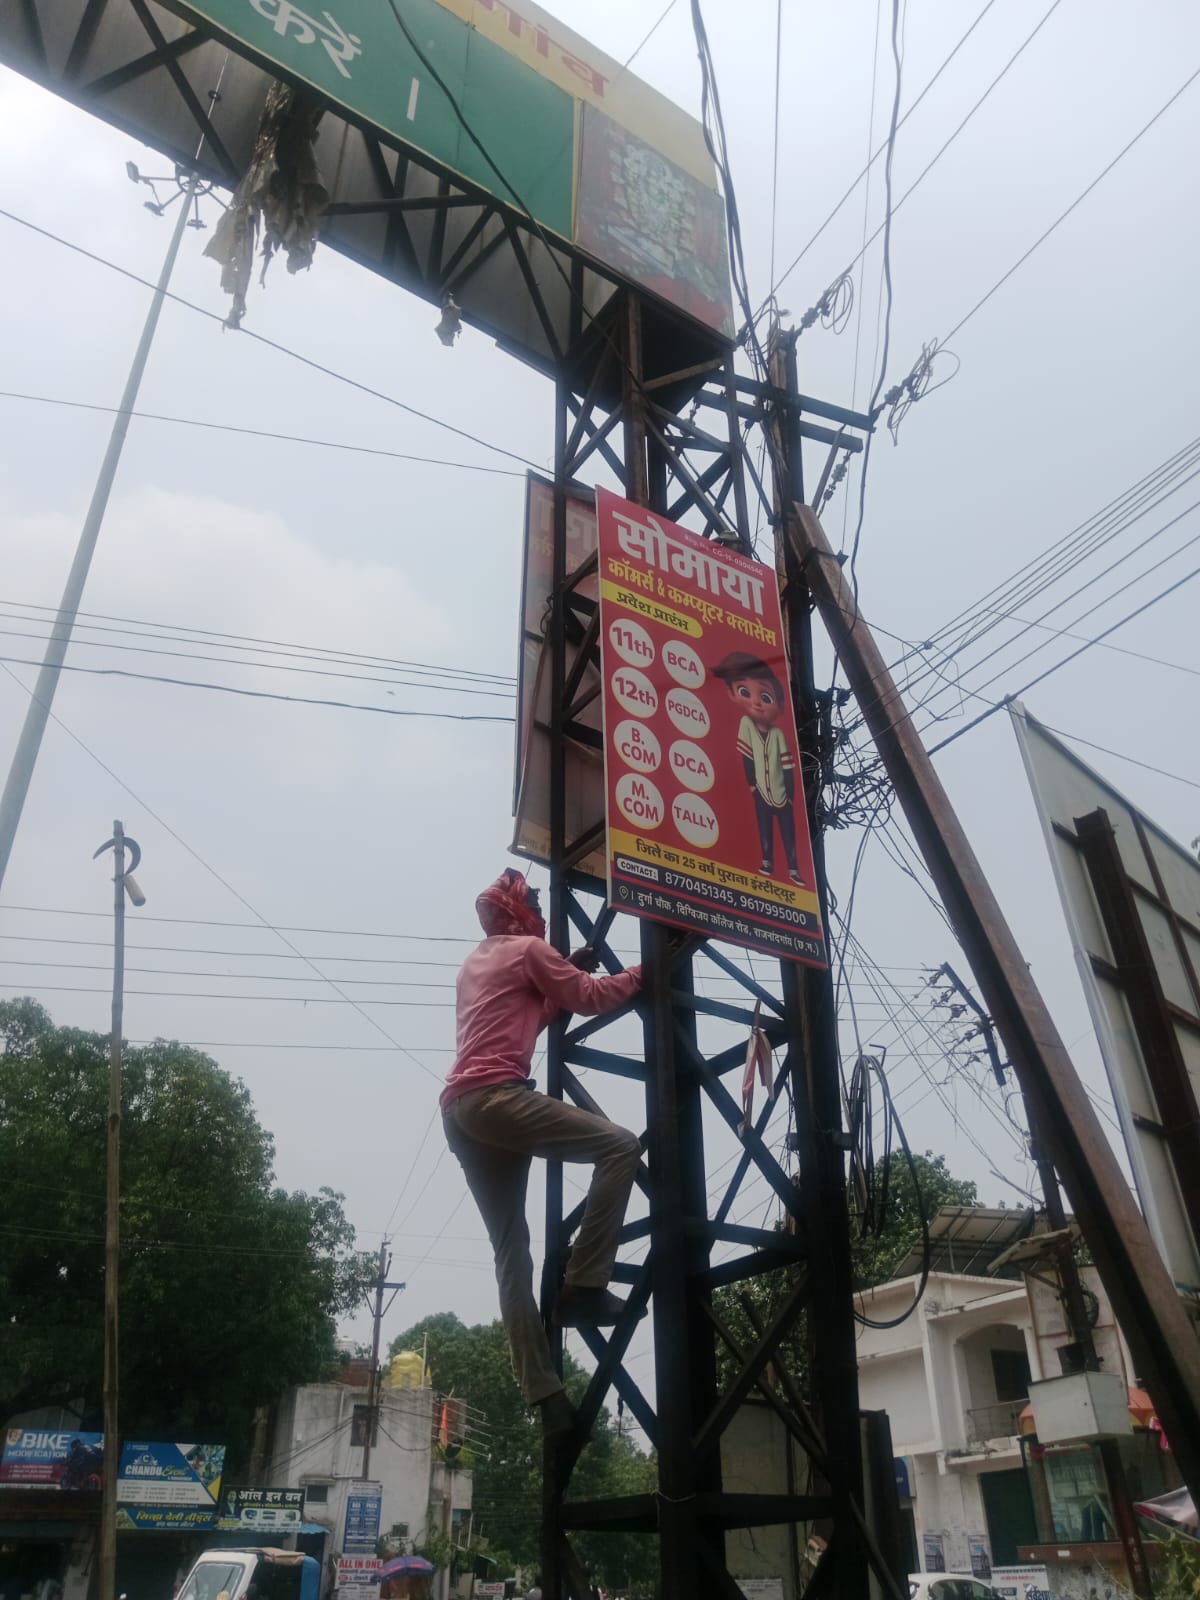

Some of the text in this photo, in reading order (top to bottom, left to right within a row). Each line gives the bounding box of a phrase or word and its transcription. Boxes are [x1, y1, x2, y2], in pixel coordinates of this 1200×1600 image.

[612, 511, 764, 616] सोमाया
[608, 557, 654, 592] कॉमर्स
[656, 578, 666, 596] &
[726, 610, 777, 646] क्लासेस
[616, 591, 652, 616] प्रवेश
[612, 626, 653, 660] 11th
[667, 650, 699, 676] BCA
[615, 677, 656, 707] 12th
[668, 699, 707, 725] PGDCA
[631, 727, 645, 745] B.
[621, 742, 657, 767] COM
[674, 752, 708, 777] DCA
[632, 780, 649, 800] M.
[623, 797, 659, 822] COM
[674, 805, 715, 830] TALLY
[635, 838, 660, 858] जिले
[663, 850, 679, 864] का
[682, 856, 695, 869] 25
[698, 861, 715, 875] वर्ष
[717, 868, 749, 886] पुराना
[621, 861, 657, 878] CONTACT:
[740, 895, 806, 925] 9617995000
[22, 1433, 71, 1449] BIKE
[125, 1465, 162, 1476] CHANDU
[239, 1489, 263, 1501] ऑल
[265, 1492, 283, 1503] इन
[339, 1559, 353, 1569] ALL
[355, 1559, 363, 1568] IN
